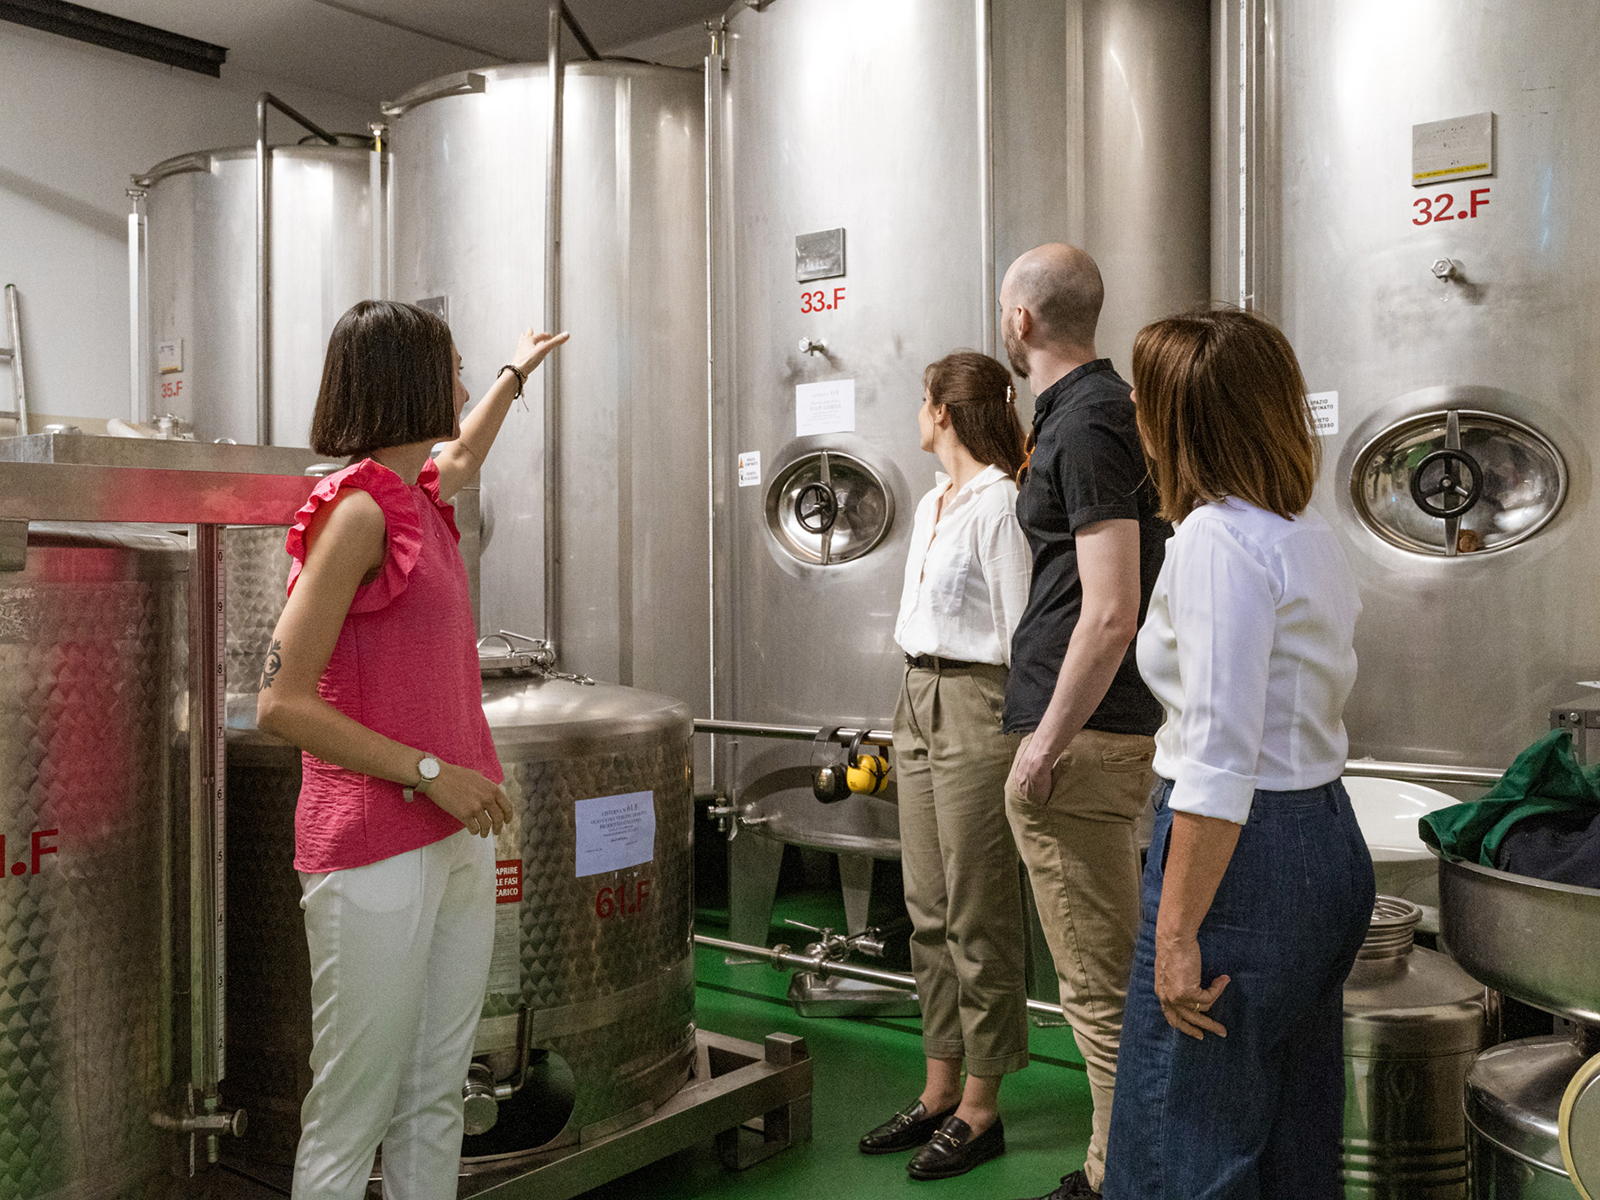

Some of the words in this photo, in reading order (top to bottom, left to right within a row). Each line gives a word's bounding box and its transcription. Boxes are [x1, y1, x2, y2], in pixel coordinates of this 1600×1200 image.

[1412, 187, 1491, 226] 32.F
[800, 286, 846, 314] 33.F
[161, 380, 183, 398] 35.F
[217, 601, 223, 611] 9
[217, 664, 222, 673] 8
[218, 726, 223, 736] 7
[217, 789, 222, 798] 6
[217, 851, 223, 861] 5
[504, 877, 518, 885] FASI
[596, 880, 649, 919] 61.F
